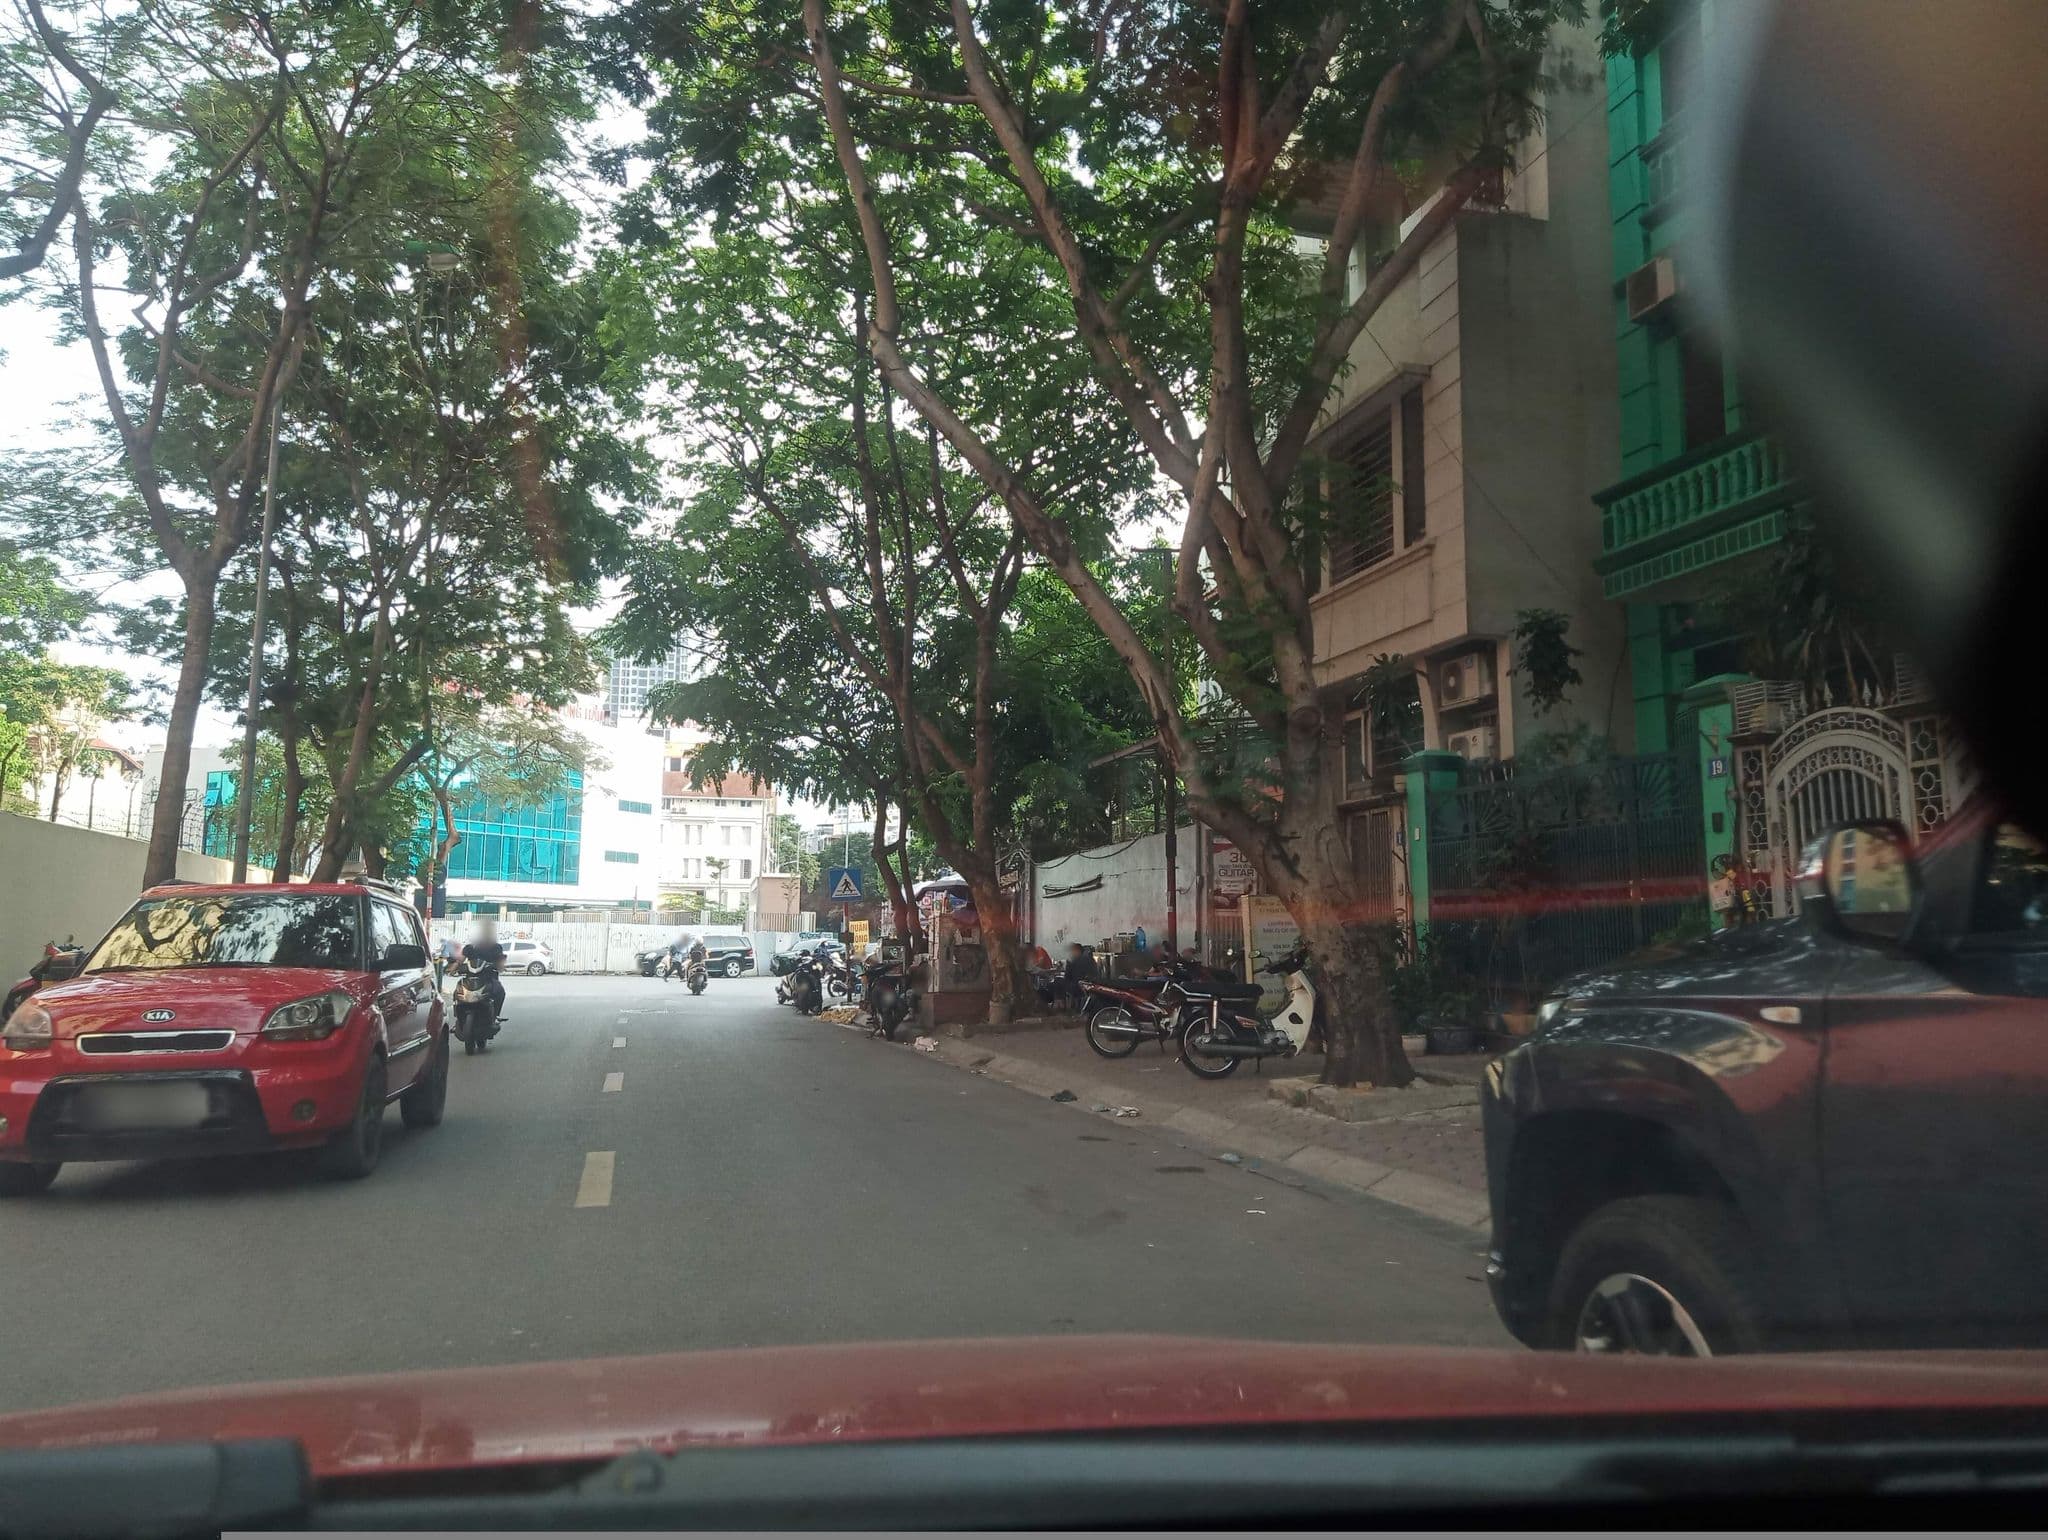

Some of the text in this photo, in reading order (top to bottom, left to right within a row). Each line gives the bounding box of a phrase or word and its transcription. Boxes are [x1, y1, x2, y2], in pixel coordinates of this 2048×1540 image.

[1712, 760, 1723, 775] 19
[1218, 868, 1255, 877] GUITAR
[145, 1010, 171, 1021] KIA
